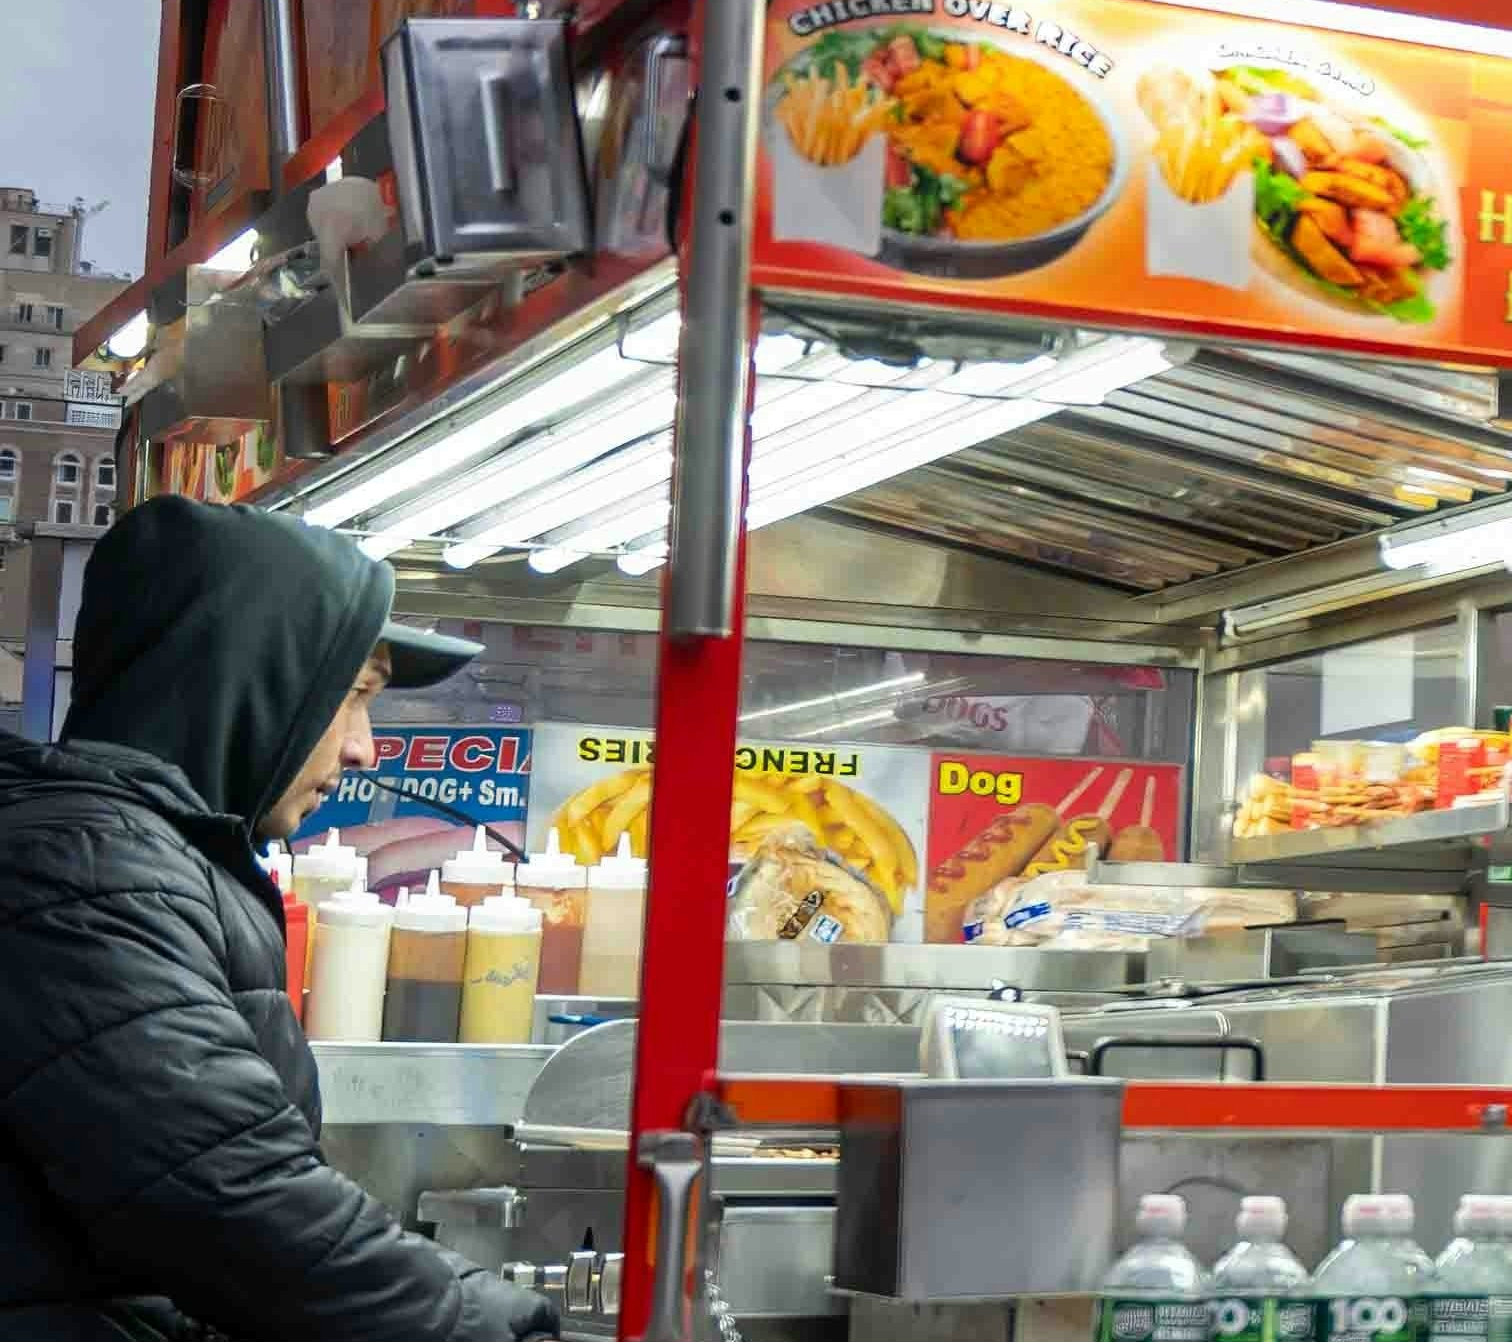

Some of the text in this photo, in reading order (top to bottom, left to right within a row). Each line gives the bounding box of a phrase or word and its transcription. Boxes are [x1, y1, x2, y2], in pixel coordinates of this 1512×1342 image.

[1035, 21, 1115, 79] RICE
[736, 748, 858, 776] FRENC
[938, 762, 1024, 805] Dog
